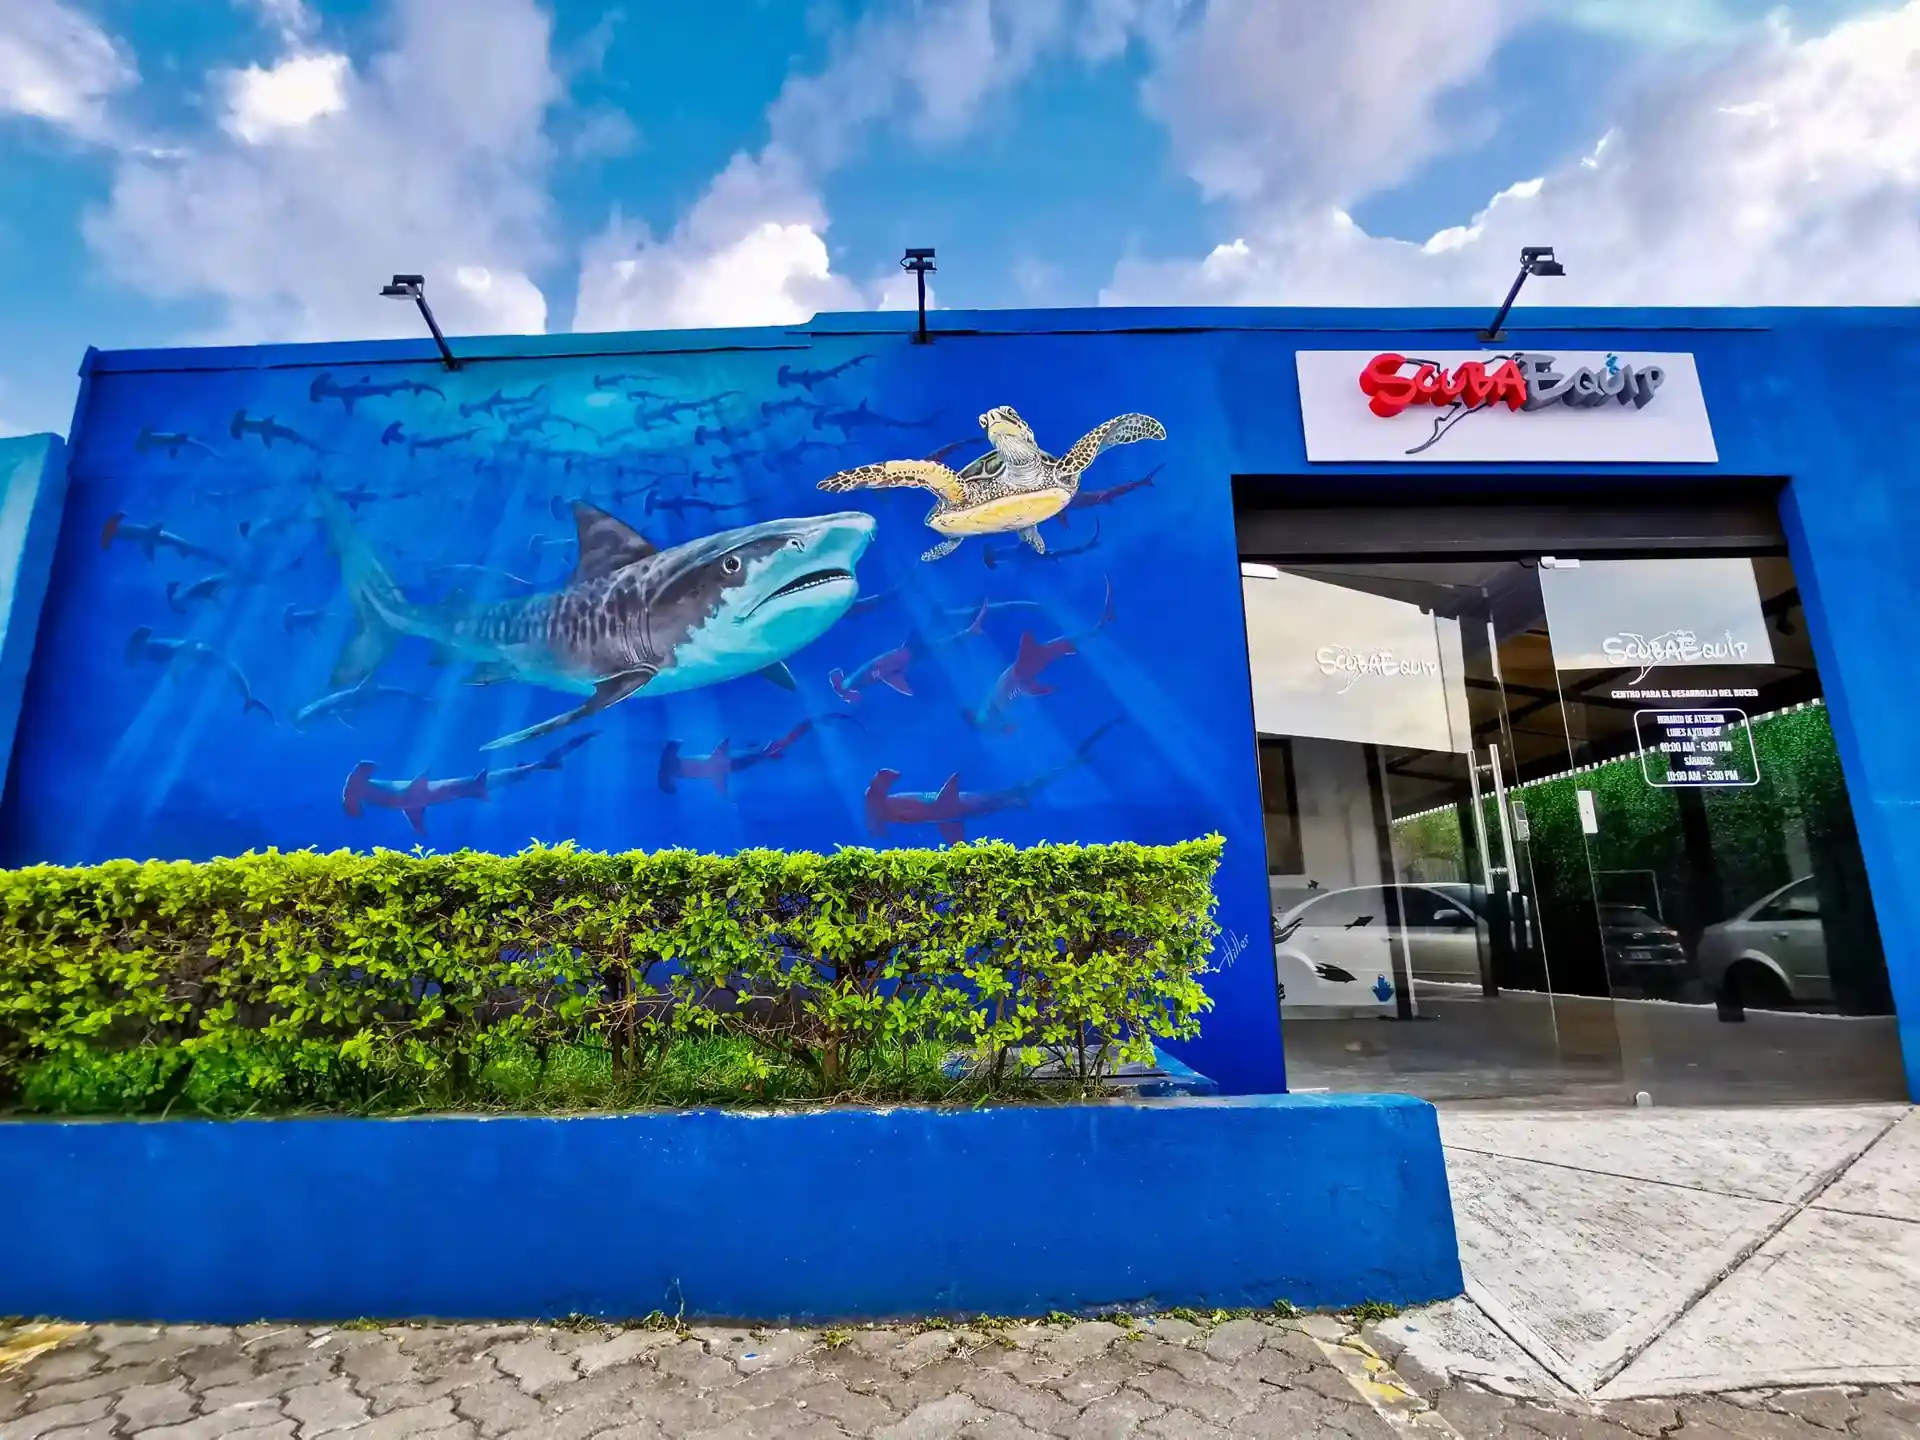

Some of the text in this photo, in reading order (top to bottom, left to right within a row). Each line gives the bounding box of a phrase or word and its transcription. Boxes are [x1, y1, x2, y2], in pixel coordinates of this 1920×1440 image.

[1611, 690, 1640, 698] CENTRO
[1641, 690, 1661, 698] PARA
[1662, 690, 1671, 698] EL
[1671, 689, 1718, 698] DESARROLLO
[1719, 689, 1733, 697] DEL
[1685, 715, 1693, 724] DE
[1694, 714, 1725, 723] ATEC
[1660, 742, 1681, 752] 10:00
[1682, 742, 1695, 752] AM
[1701, 741, 1718, 751] 6:00
[1719, 741, 1733, 751] PM
[1667, 771, 1687, 781] 10:00
[1688, 771, 1702, 781] AM
[1707, 770, 1724, 780] 5:00
[1725, 770, 1738, 780] PM
